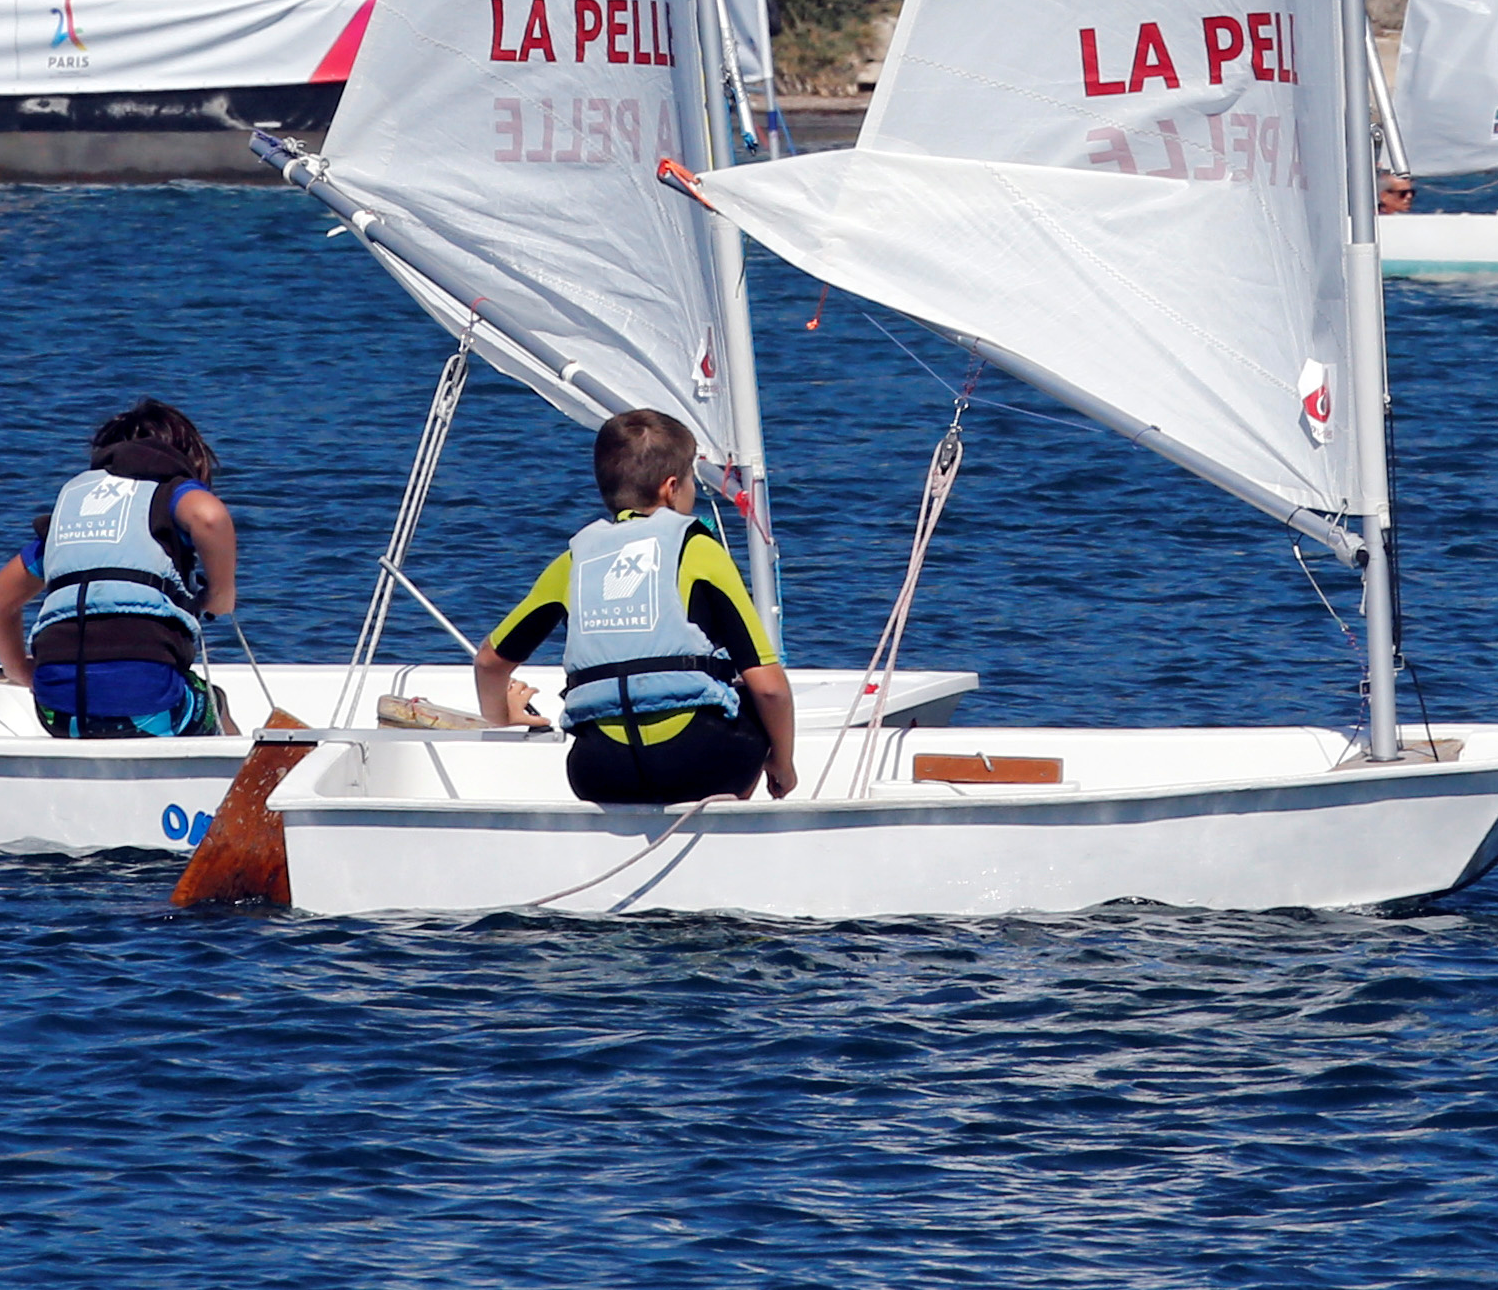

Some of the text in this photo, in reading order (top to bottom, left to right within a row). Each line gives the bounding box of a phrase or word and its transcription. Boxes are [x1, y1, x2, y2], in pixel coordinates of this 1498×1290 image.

[47, 55, 90, 69] PARIS
[1078, 21, 1181, 98] LA
[59, 529, 116, 540] POPULAIRE
[583, 604, 648, 618] BANQUE
[583, 616, 648, 628] POPULAIRE
